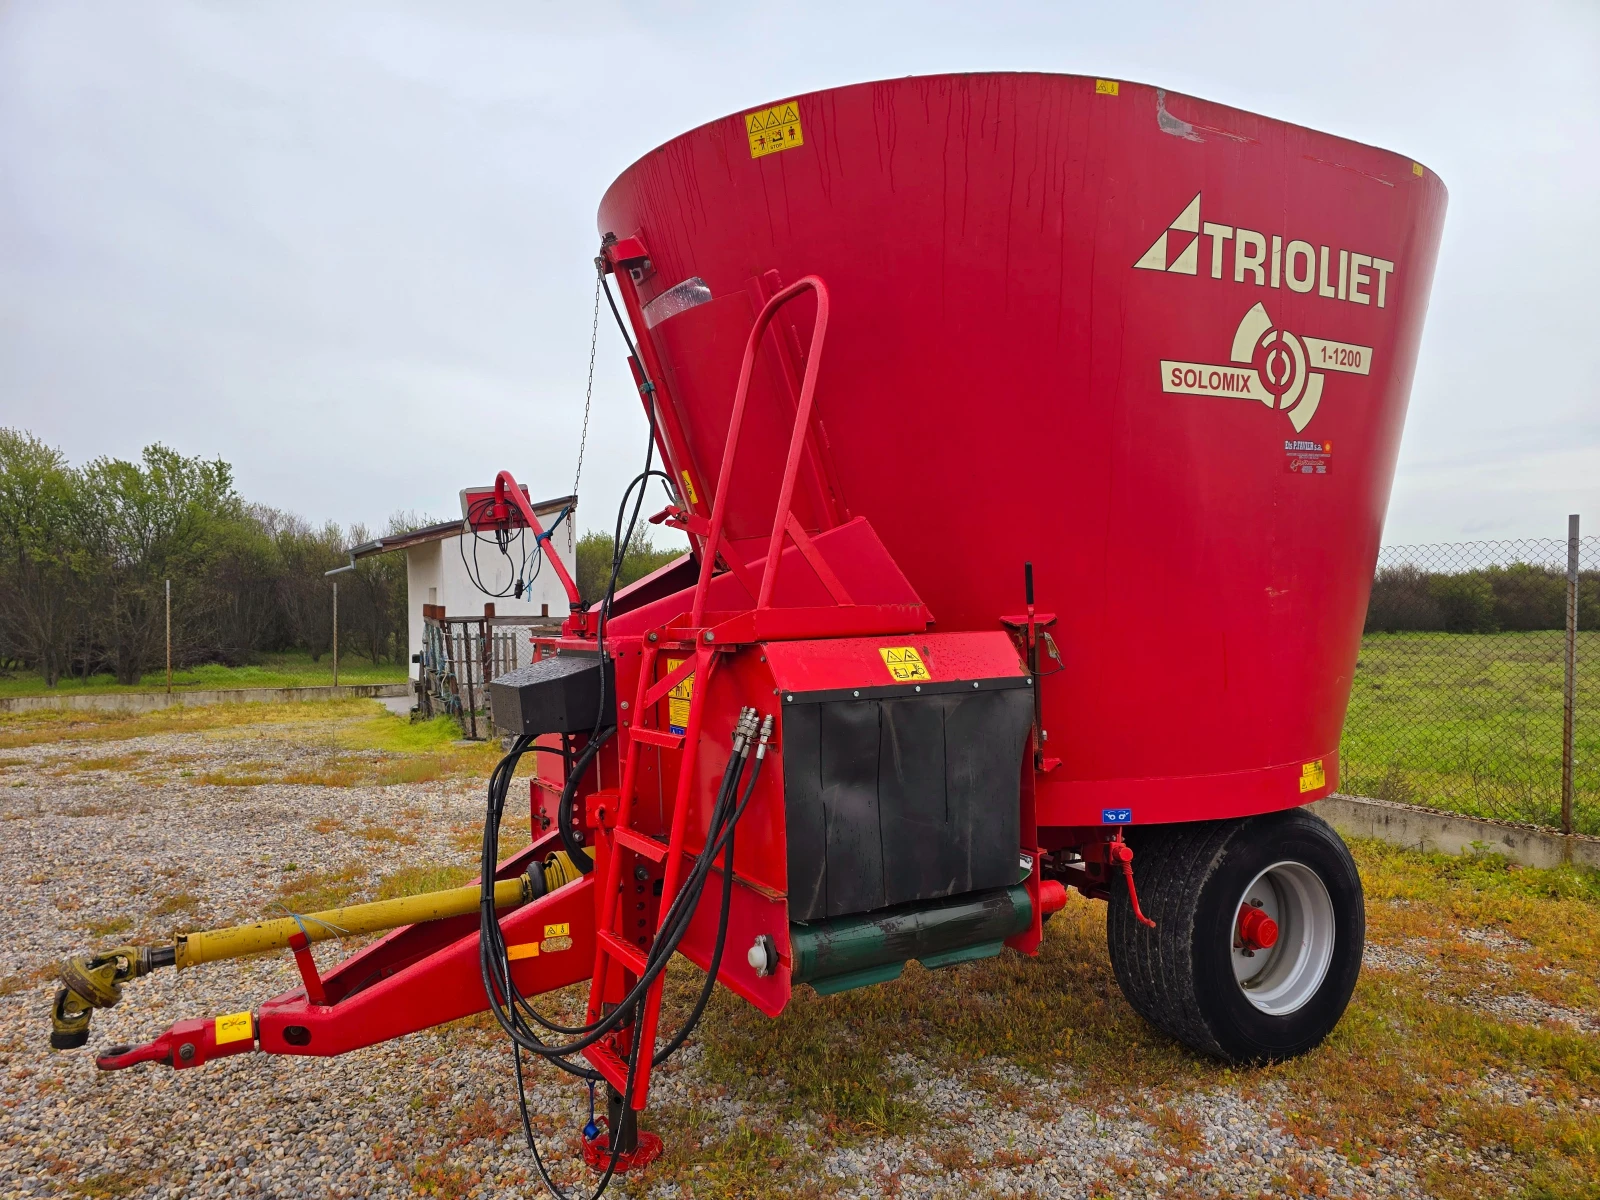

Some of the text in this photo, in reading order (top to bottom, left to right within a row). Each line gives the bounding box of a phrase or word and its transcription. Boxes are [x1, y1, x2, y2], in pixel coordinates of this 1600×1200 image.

[1202, 221, 1395, 309] TRIOLIET
[1321, 345, 1362, 368] 1-1200
[1171, 367, 1251, 394] SOLOMIX
